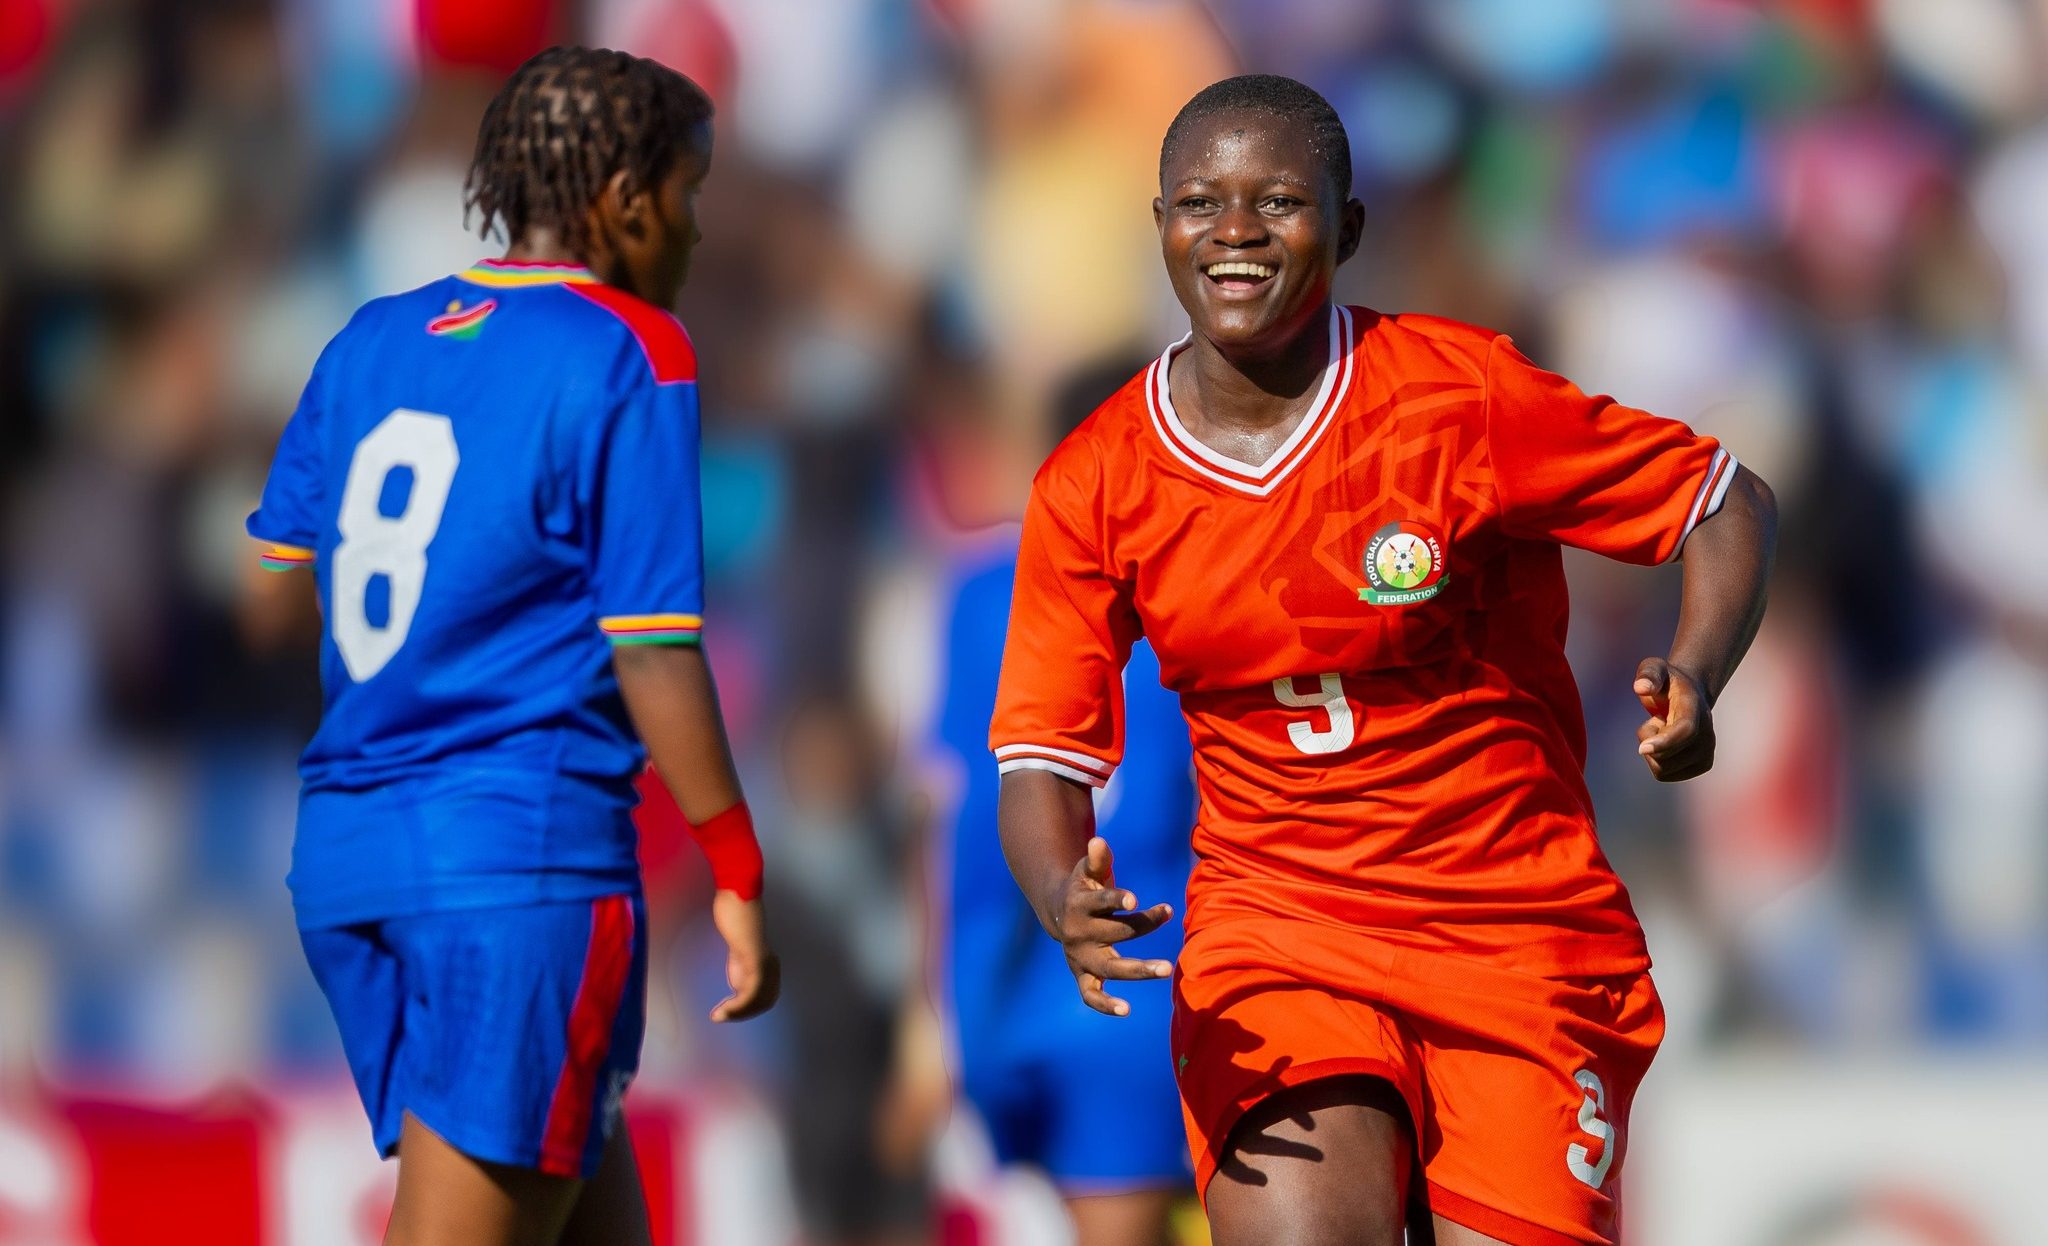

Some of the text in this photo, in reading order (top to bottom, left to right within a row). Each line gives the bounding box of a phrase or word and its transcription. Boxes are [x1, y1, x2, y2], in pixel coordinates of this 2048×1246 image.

[331, 406, 461, 683] 8
[1366, 535, 1384, 587] FOOTBALL
[1427, 536, 1442, 572] KENYA
[1377, 586, 1438, 603] FEDERATION
